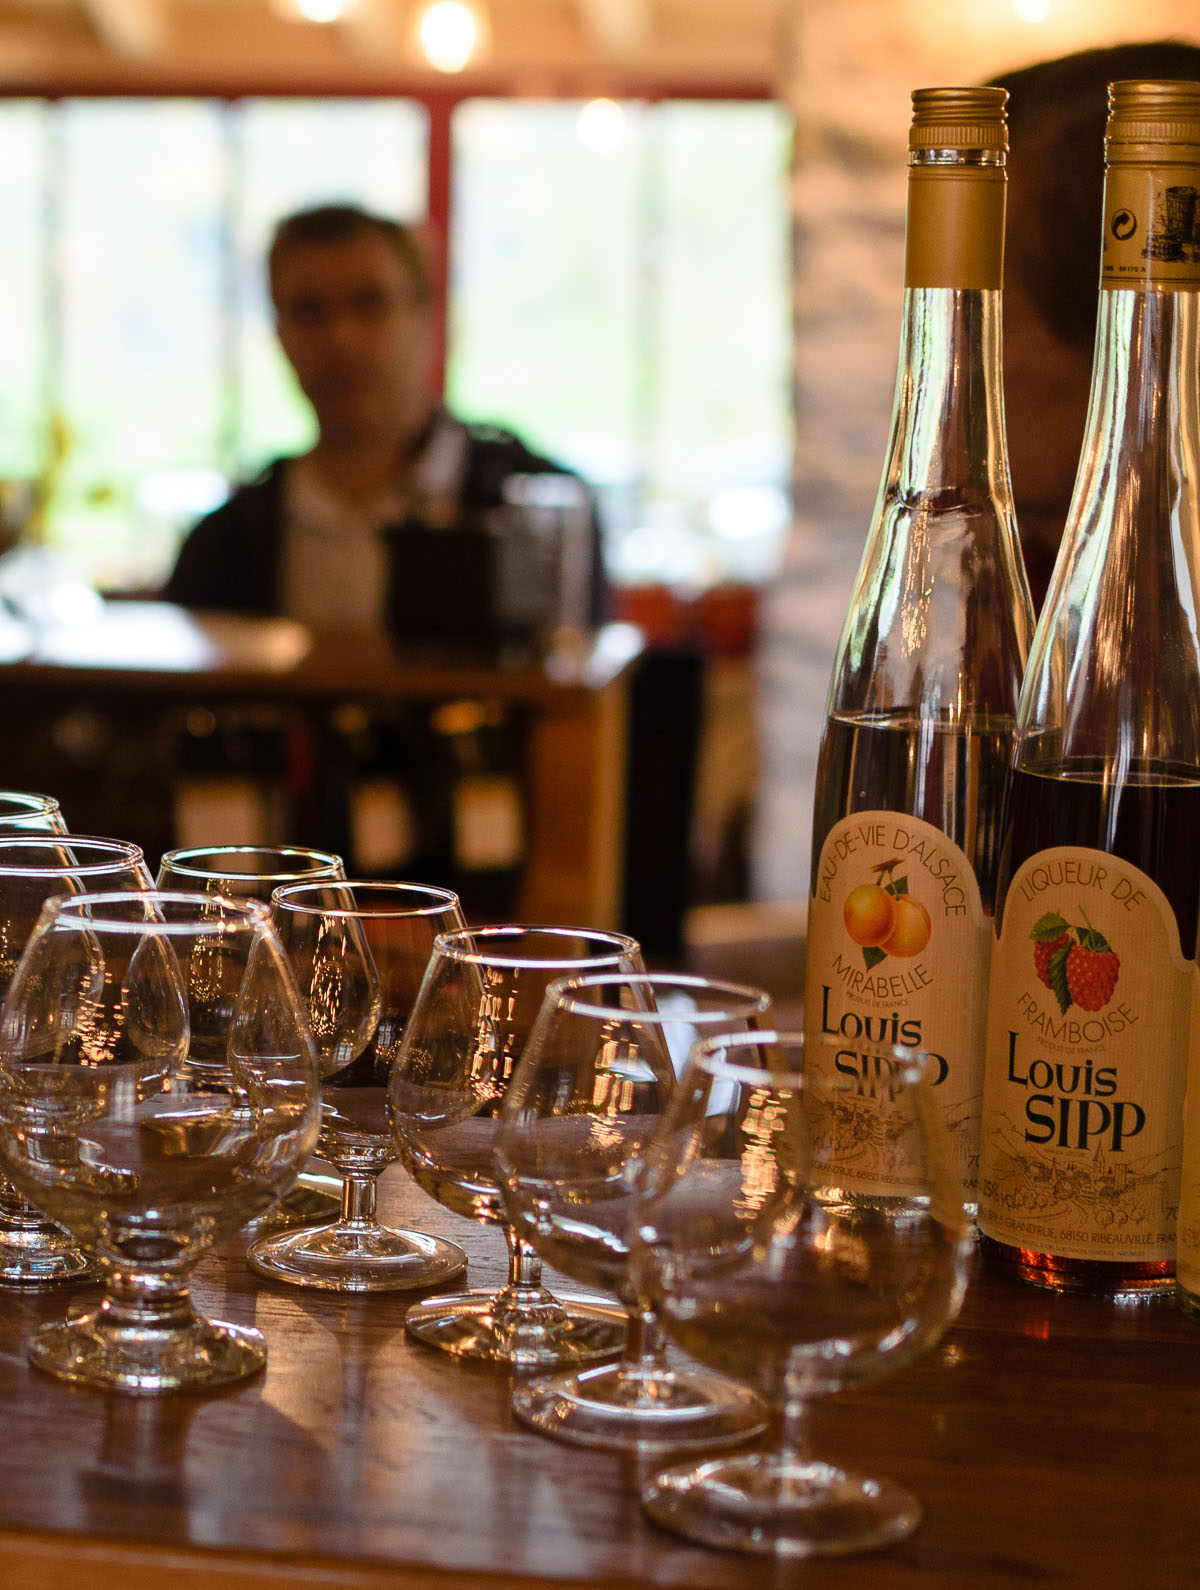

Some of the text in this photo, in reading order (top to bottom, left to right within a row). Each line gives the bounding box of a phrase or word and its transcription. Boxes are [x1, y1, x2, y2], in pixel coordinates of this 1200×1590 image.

[821, 825, 967, 917] EAU-DE-VIE D'ALSACE
[1020, 861, 1147, 912] LIQUEUR DE
[832, 953, 934, 999] MIRABELLE
[822, 984, 922, 1048] Louis
[1016, 991, 1140, 1044] FRAMBOISE
[1008, 1030, 1118, 1098] Louis
[1024, 1094, 1146, 1153] SIPP
[1059, 1230, 1089, 1242] 68150
